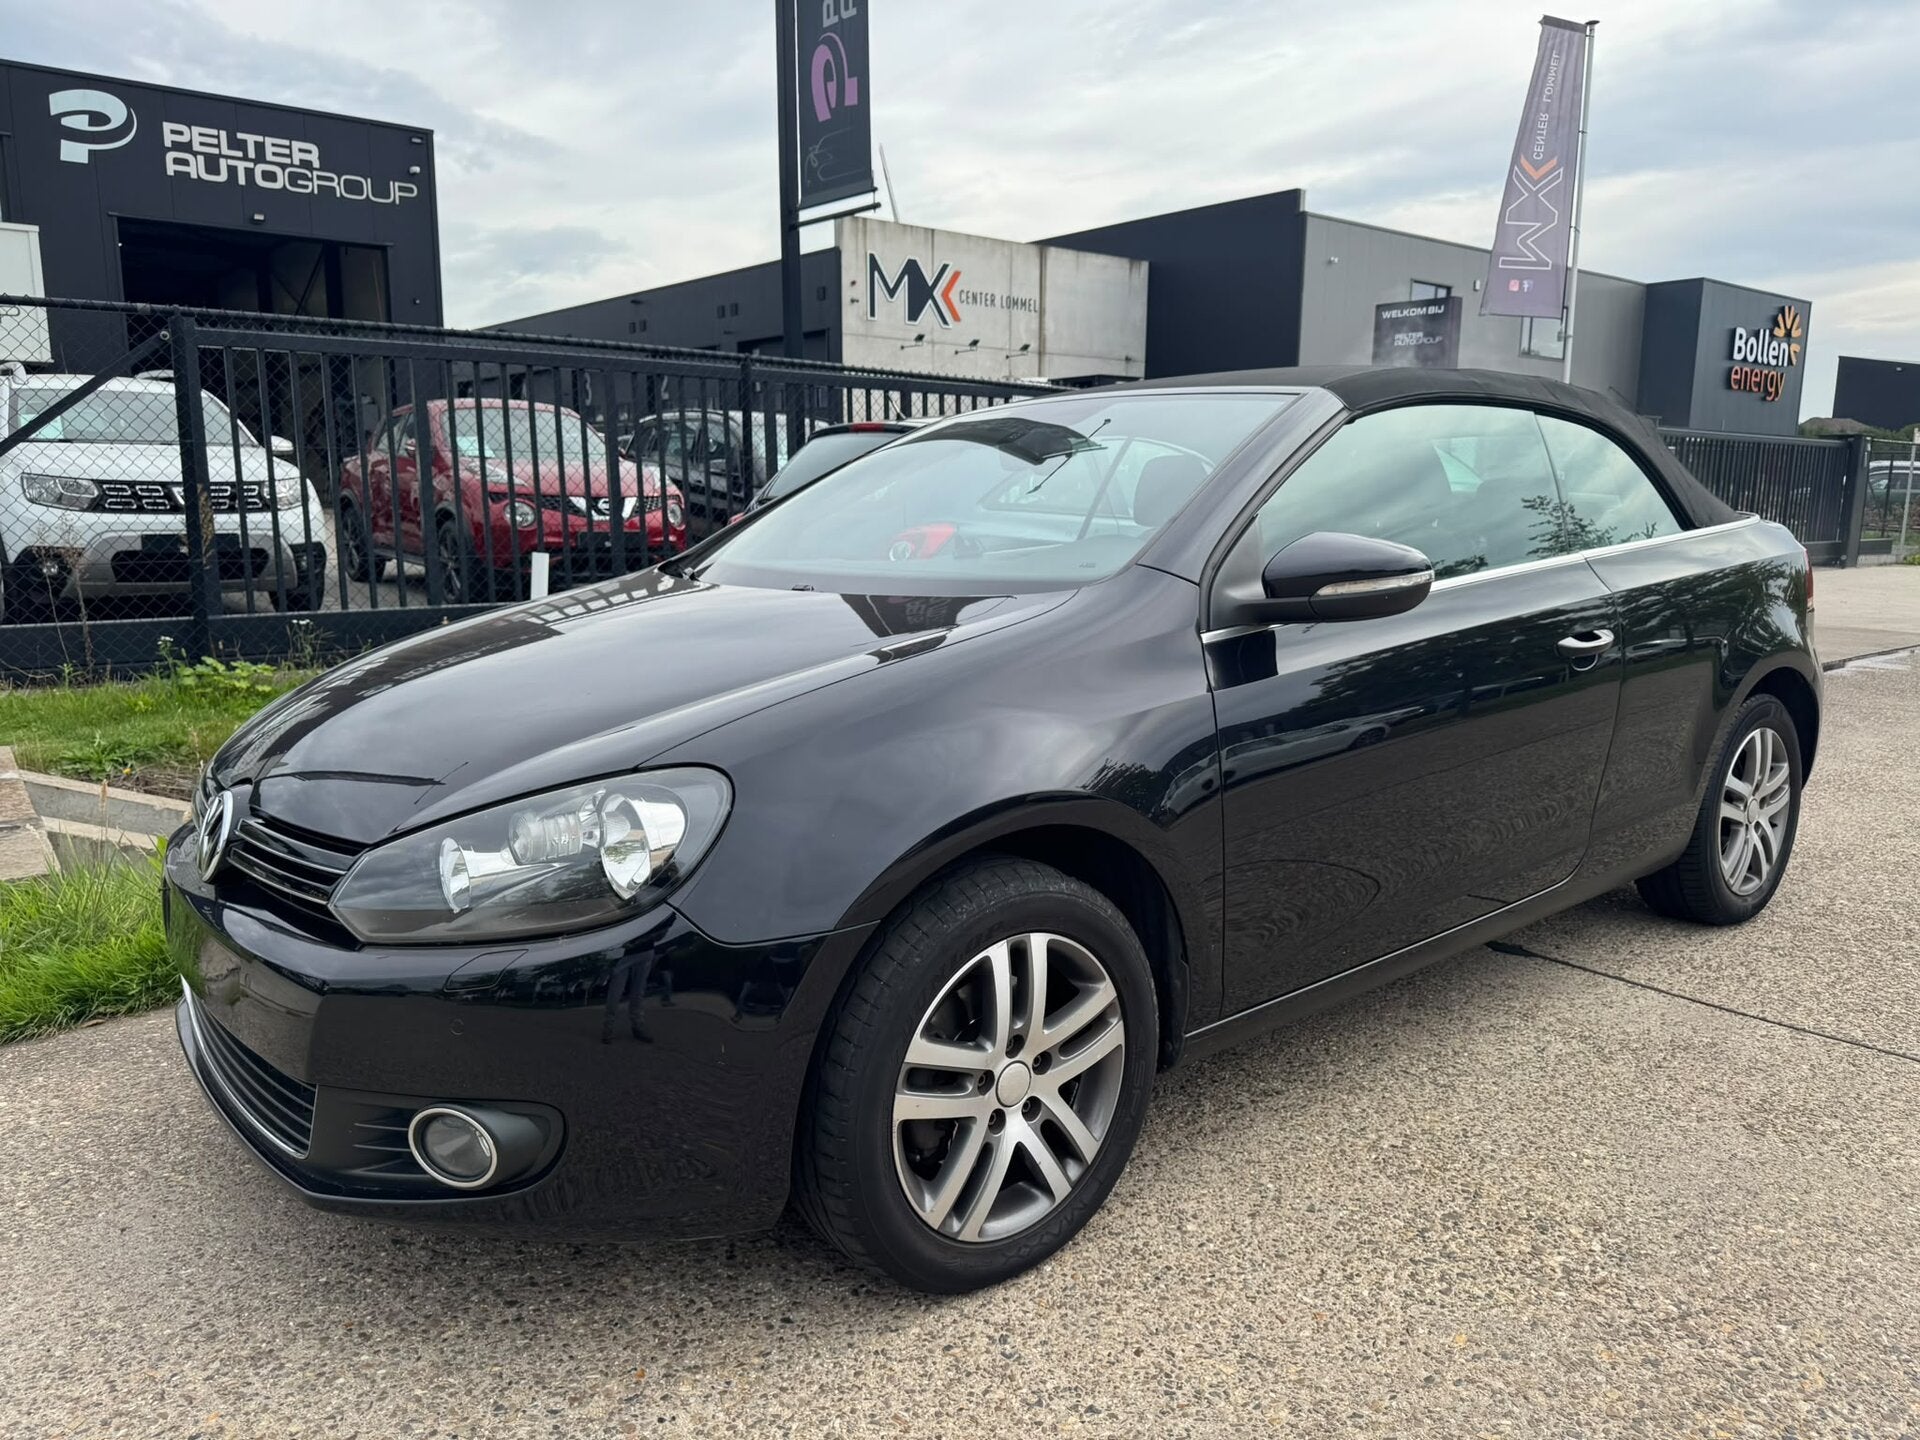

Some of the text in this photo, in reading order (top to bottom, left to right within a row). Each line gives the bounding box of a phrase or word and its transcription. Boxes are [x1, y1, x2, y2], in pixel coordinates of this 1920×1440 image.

[162, 121, 320, 169] PELTER
[165, 151, 418, 205] AUTOGROUP
[959, 289, 996, 308] CENTER
[1000, 294, 1039, 313] LOMMEL
[1381, 304, 1445, 319] WELKOM BIJ
[1733, 326, 1789, 367] Bollen
[1730, 365, 1786, 401] energy
